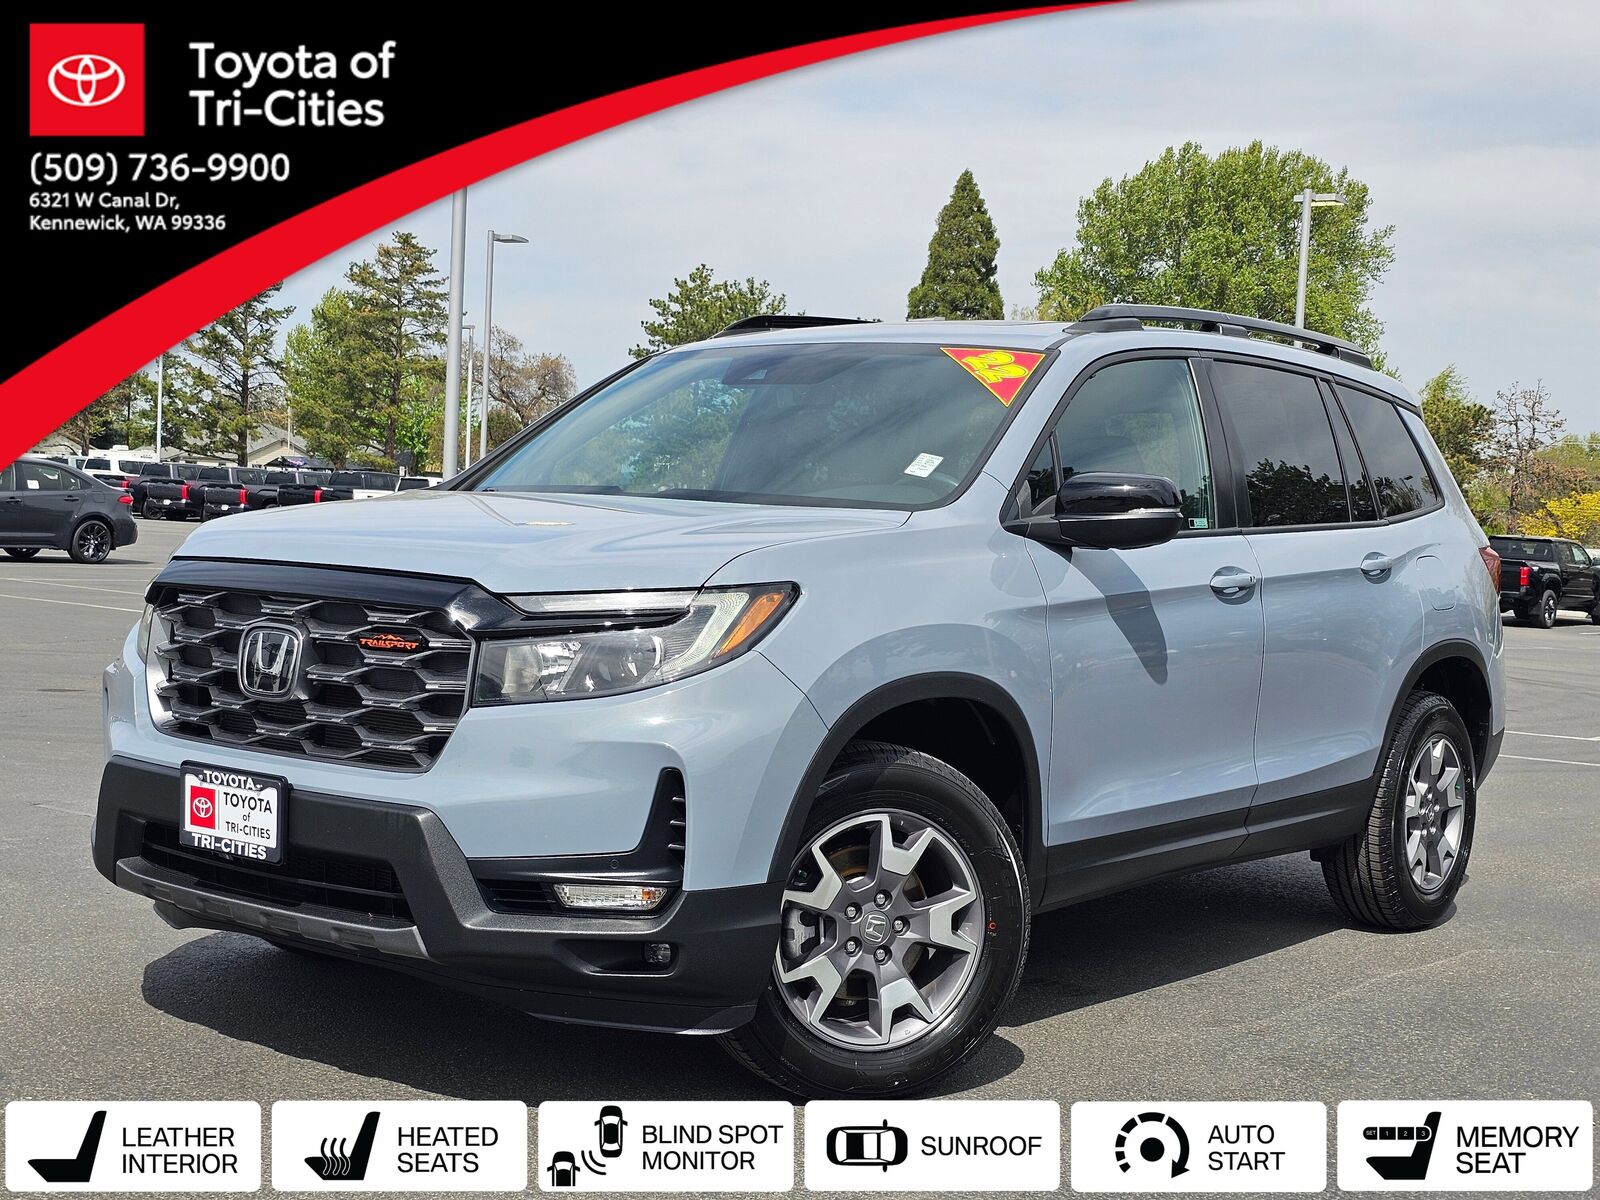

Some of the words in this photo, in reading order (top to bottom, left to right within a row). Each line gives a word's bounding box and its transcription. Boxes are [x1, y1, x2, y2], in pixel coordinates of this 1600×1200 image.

[961, 350, 1029, 383] 22
[359, 638, 419, 650] TRAILSPORT
[203, 770, 256, 791] TOYOTA
[223, 792, 273, 814] TOYOTA
[242, 813, 251, 822] of
[225, 821, 271, 840] TRI-CITIES
[191, 833, 267, 860] TRI-CITIES
